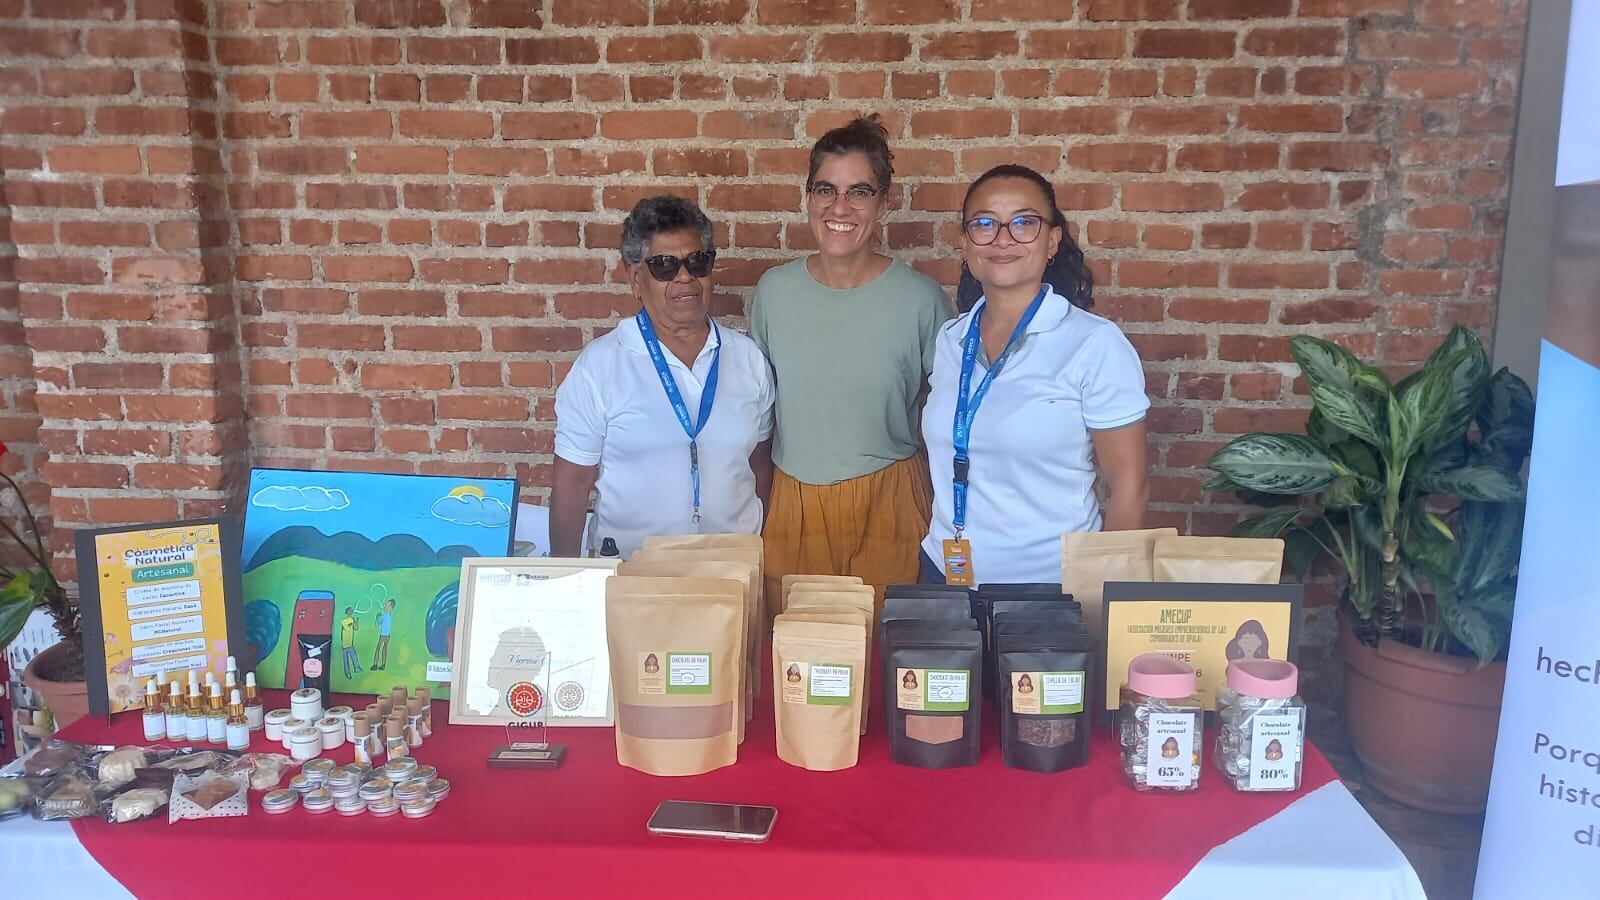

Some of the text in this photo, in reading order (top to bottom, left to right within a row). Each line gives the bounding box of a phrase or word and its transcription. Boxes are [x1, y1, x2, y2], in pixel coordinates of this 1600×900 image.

[135, 552, 186, 566] Natural
[136, 564, 190, 579] Artesanal
[1160, 608, 1192, 624] AMECUP
[1157, 766, 1185, 777] 65%
[1259, 768, 1289, 779] 80%
